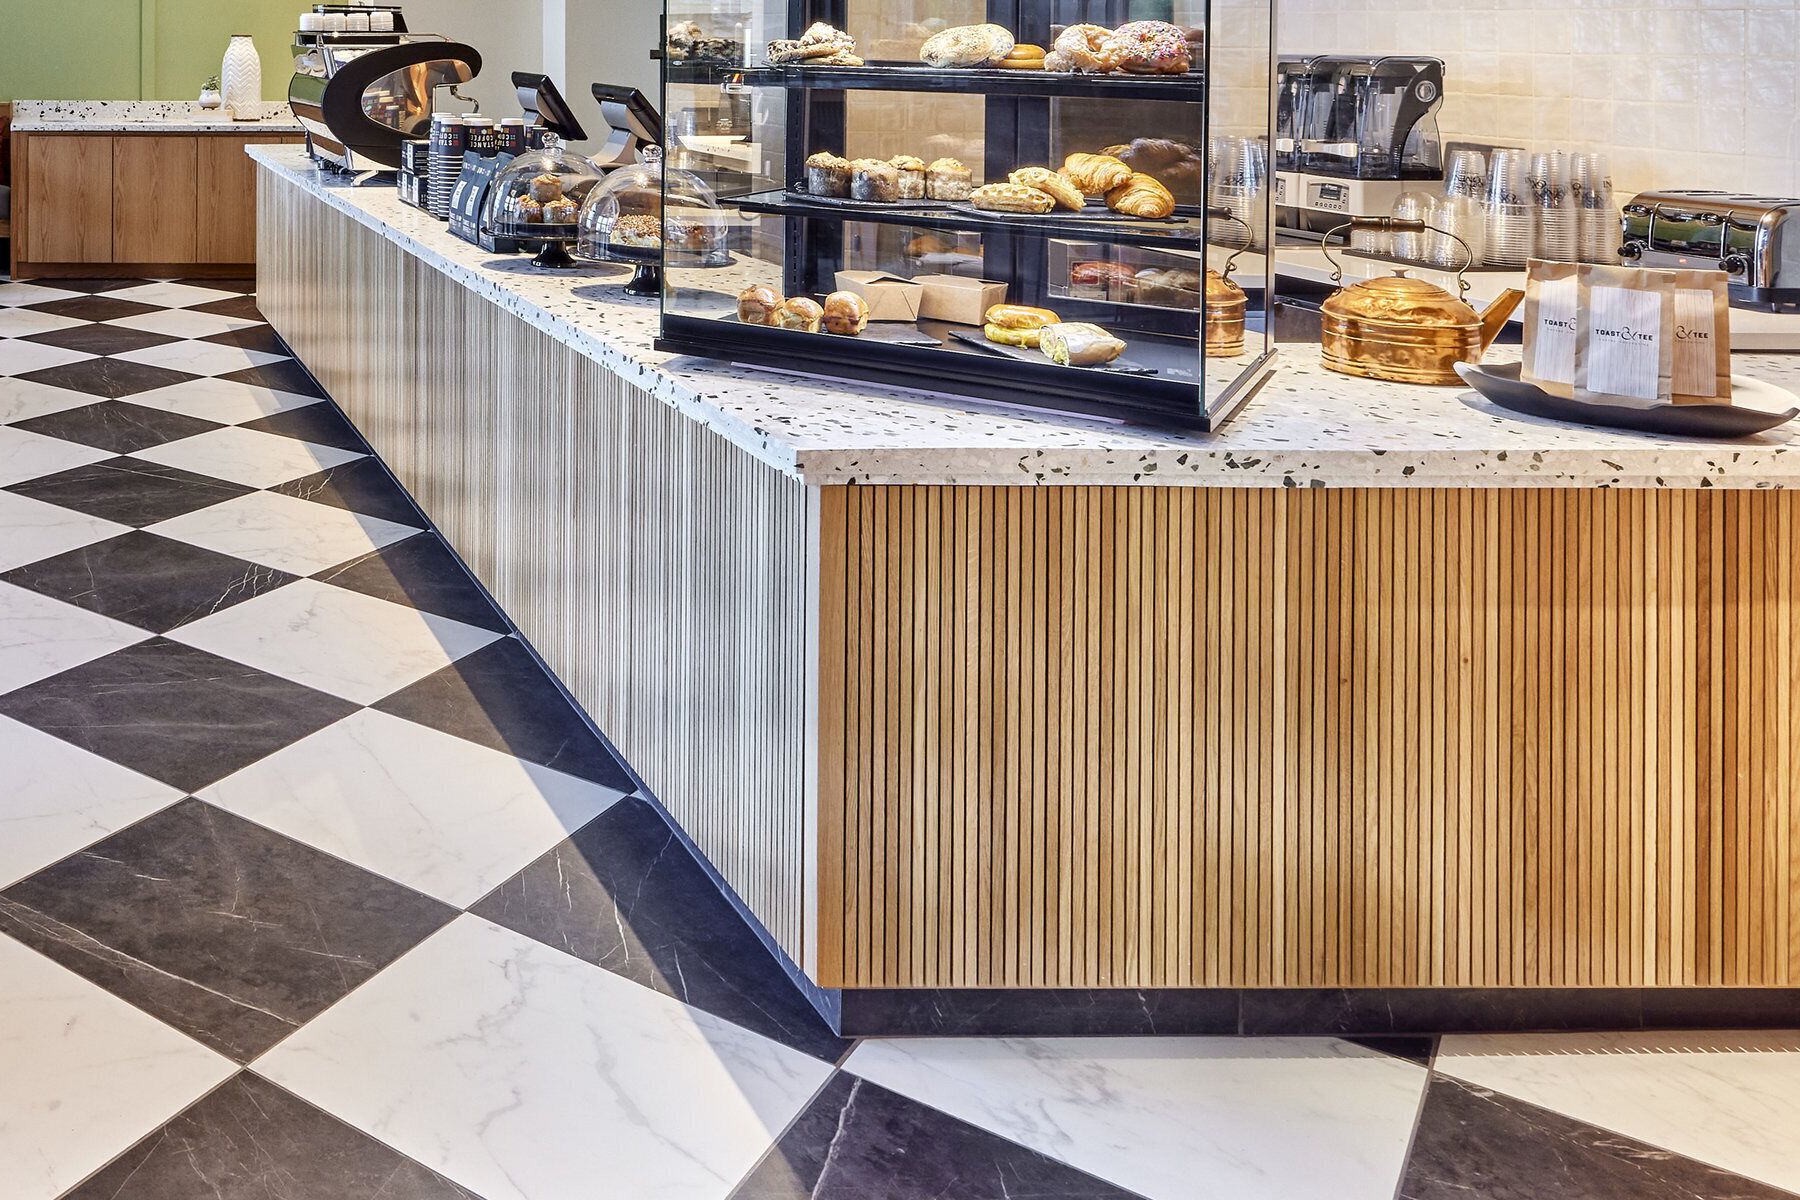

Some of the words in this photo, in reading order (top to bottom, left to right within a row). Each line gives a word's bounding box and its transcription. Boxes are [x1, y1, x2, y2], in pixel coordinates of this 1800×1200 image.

[1544, 319, 1567, 328] TOAST
[1595, 328, 1620, 337] TOAST
[1620, 326, 1637, 341] &
[1637, 333, 1653, 342] TEE
